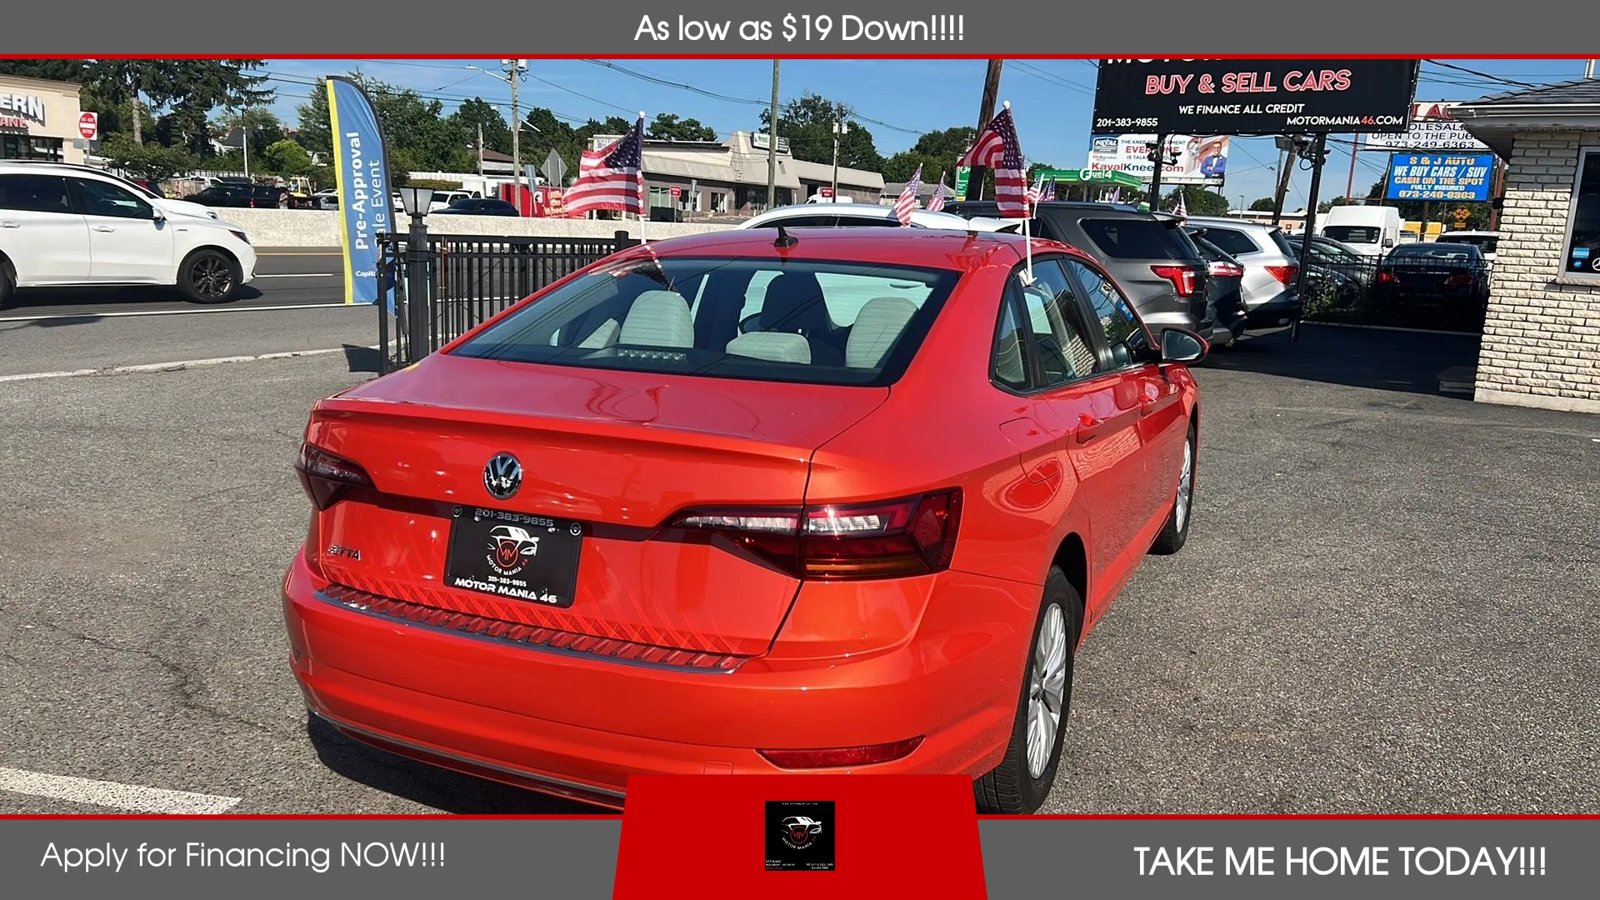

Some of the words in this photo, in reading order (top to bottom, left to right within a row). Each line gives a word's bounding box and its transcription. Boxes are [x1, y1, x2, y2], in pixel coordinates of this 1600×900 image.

[1145, 74, 1194, 95] BUY
[1198, 74, 1215, 94] &
[1221, 72, 1277, 93] SELL
[1283, 69, 1352, 92] CARS
[1179, 105, 1195, 114] WE
[1196, 105, 1241, 114] FINANCE
[1243, 104, 1263, 114] ALL
[1265, 104, 1305, 114] CREDIT
[1096, 118, 1158, 127] 201-383-9855
[1286, 116, 1403, 126] MOTORMANIA46.COM
[1372, 132, 1402, 140] OPEN
[1424, 132, 1446, 140] THE
[1394, 166, 1409, 177] WE
[1409, 166, 1430, 177] BUY
[1430, 167, 1458, 178] CARS
[1466, 167, 1488, 178] SUV
[368, 159, 384, 207] Event
[1394, 177, 1420, 185] CASH
[1422, 177, 1436, 185] ON
[1439, 177, 1456, 185] THE
[1458, 178, 1484, 186] SPOT
[346, 132, 369, 250] Pre-Approval
[474, 508, 554, 527] 201-383-9855
[454, 578, 496, 593] MOTOR
[497, 585, 537, 600] MANIA
[539, 593, 557, 603] 46
